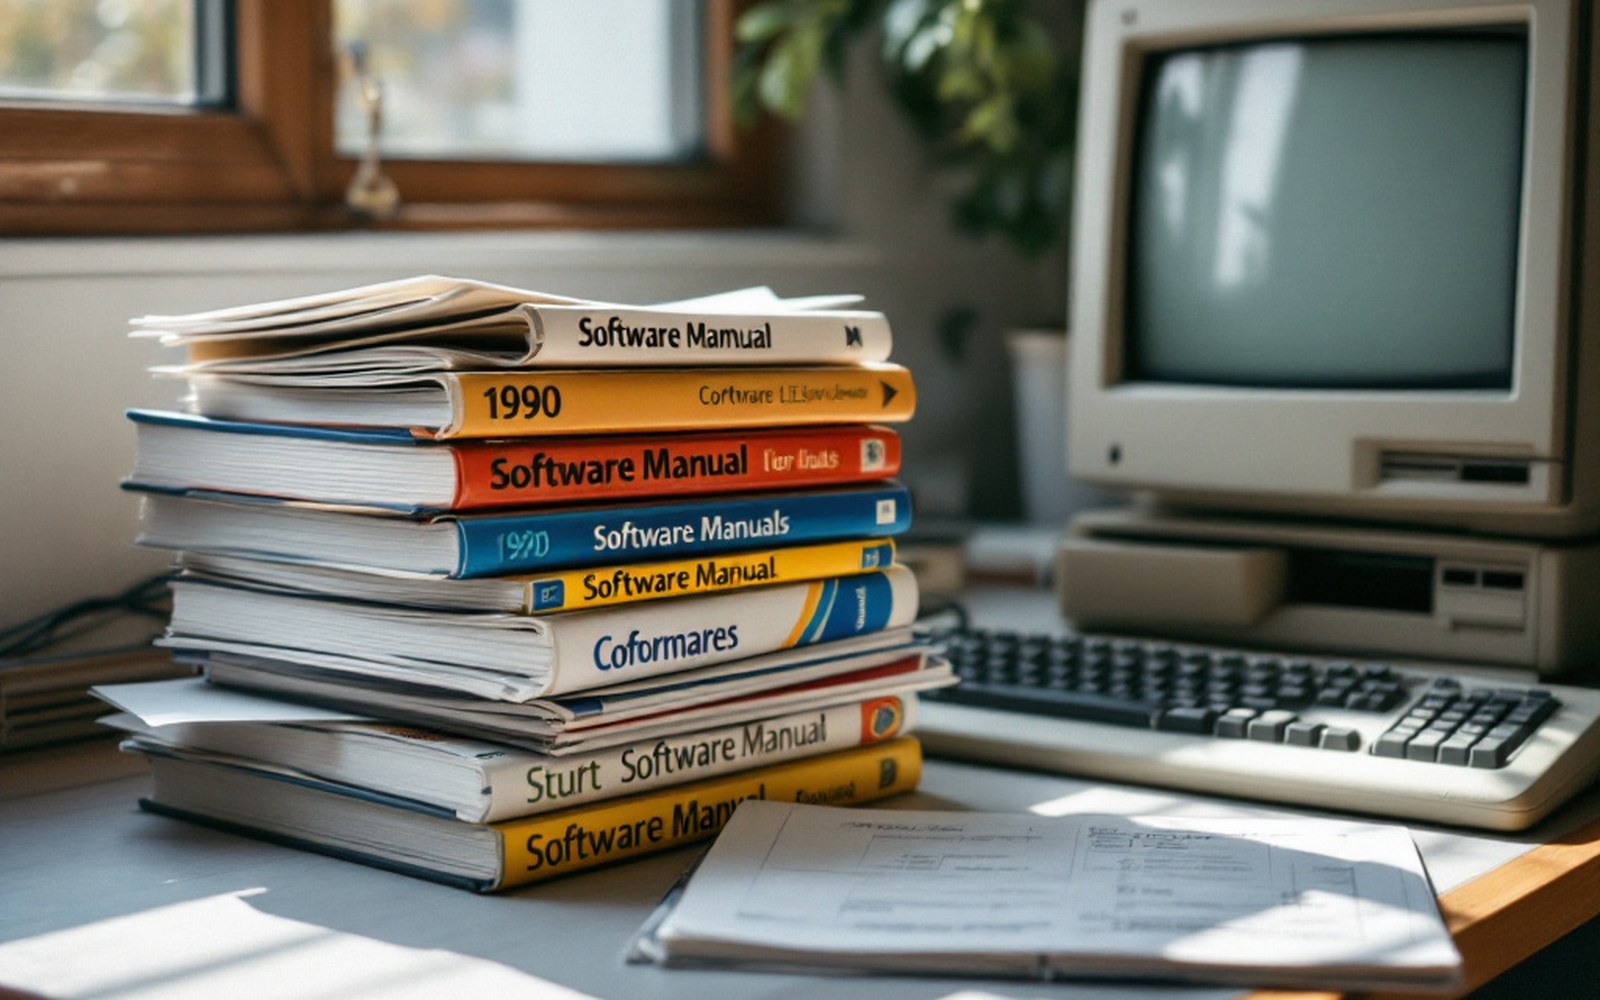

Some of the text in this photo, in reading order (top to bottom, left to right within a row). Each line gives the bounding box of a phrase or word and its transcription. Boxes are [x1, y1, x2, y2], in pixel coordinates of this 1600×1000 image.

[579, 317, 681, 348] Software
[484, 386, 561, 420] 1990
[490, 452, 635, 490] Software
[643, 445, 748, 480] Manual
[593, 511, 790, 552] Software Manuals
[583, 561, 690, 600] Software
[696, 556, 777, 589] Manual
[594, 624, 739, 671] Coformares
[526, 714, 827, 804] Sturt Software Manual
[526, 811, 663, 871] Software
